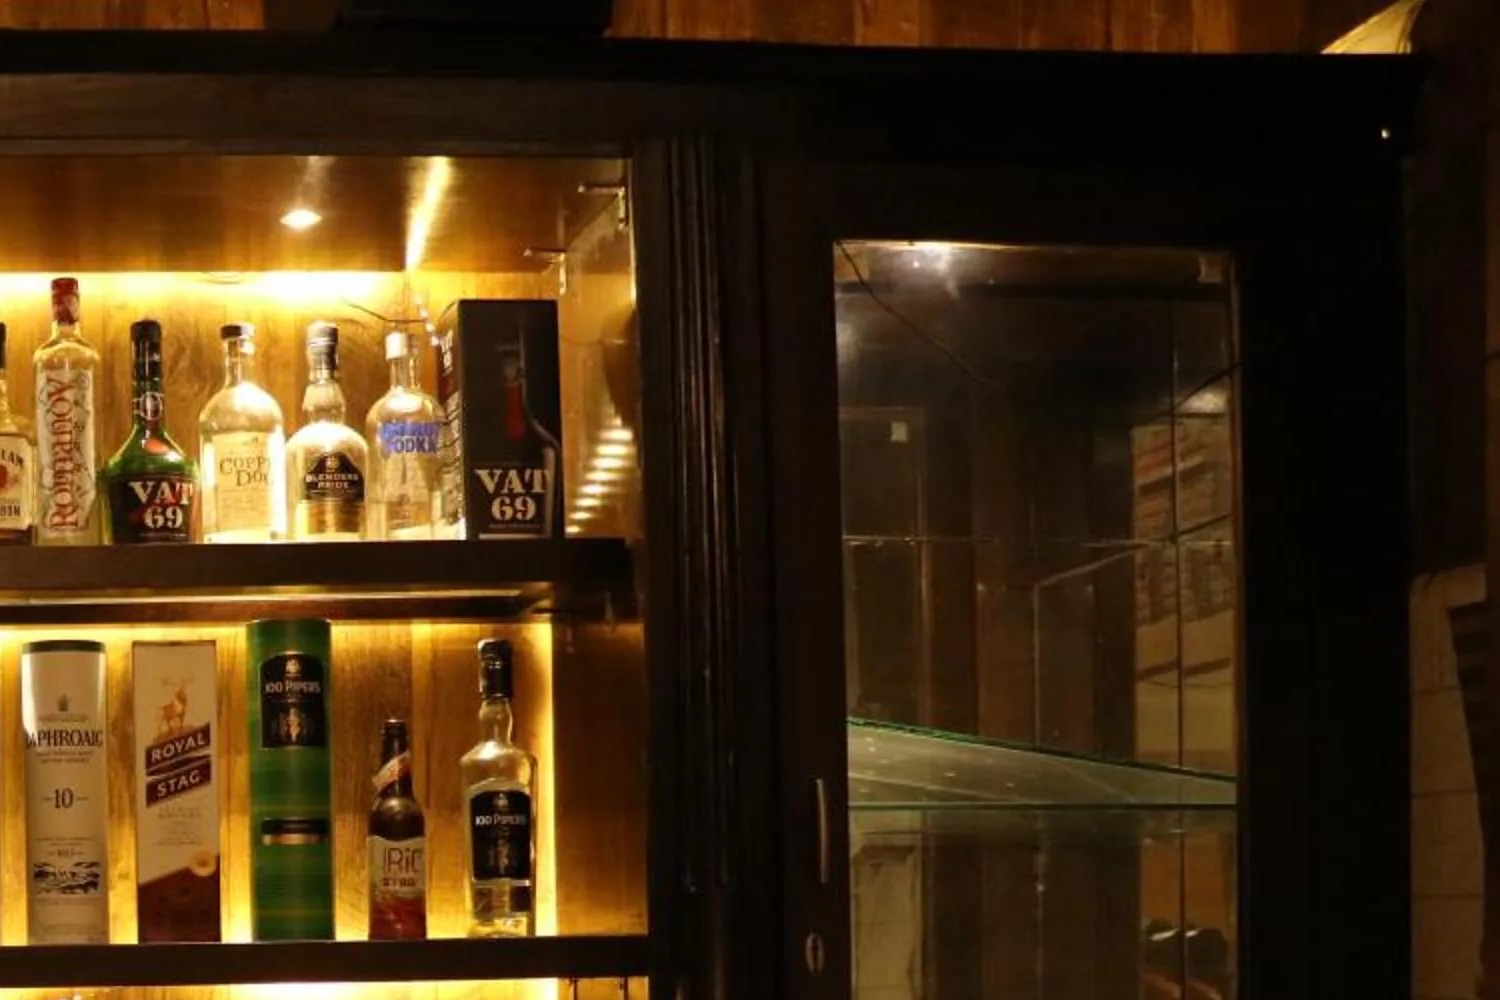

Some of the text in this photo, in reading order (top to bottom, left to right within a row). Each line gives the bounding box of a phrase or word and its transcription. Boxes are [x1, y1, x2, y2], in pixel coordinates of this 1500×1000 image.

[219, 457, 271, 477] COPP
[128, 480, 196, 506] VAT
[474, 468, 550, 494] VAT
[143, 506, 184, 530] 69
[491, 496, 537, 521] 69
[27, 729, 103, 750] APHROAIG
[150, 733, 206, 763] ROYAL
[156, 769, 201, 798] STAG
[54, 787, 75, 809] 10
